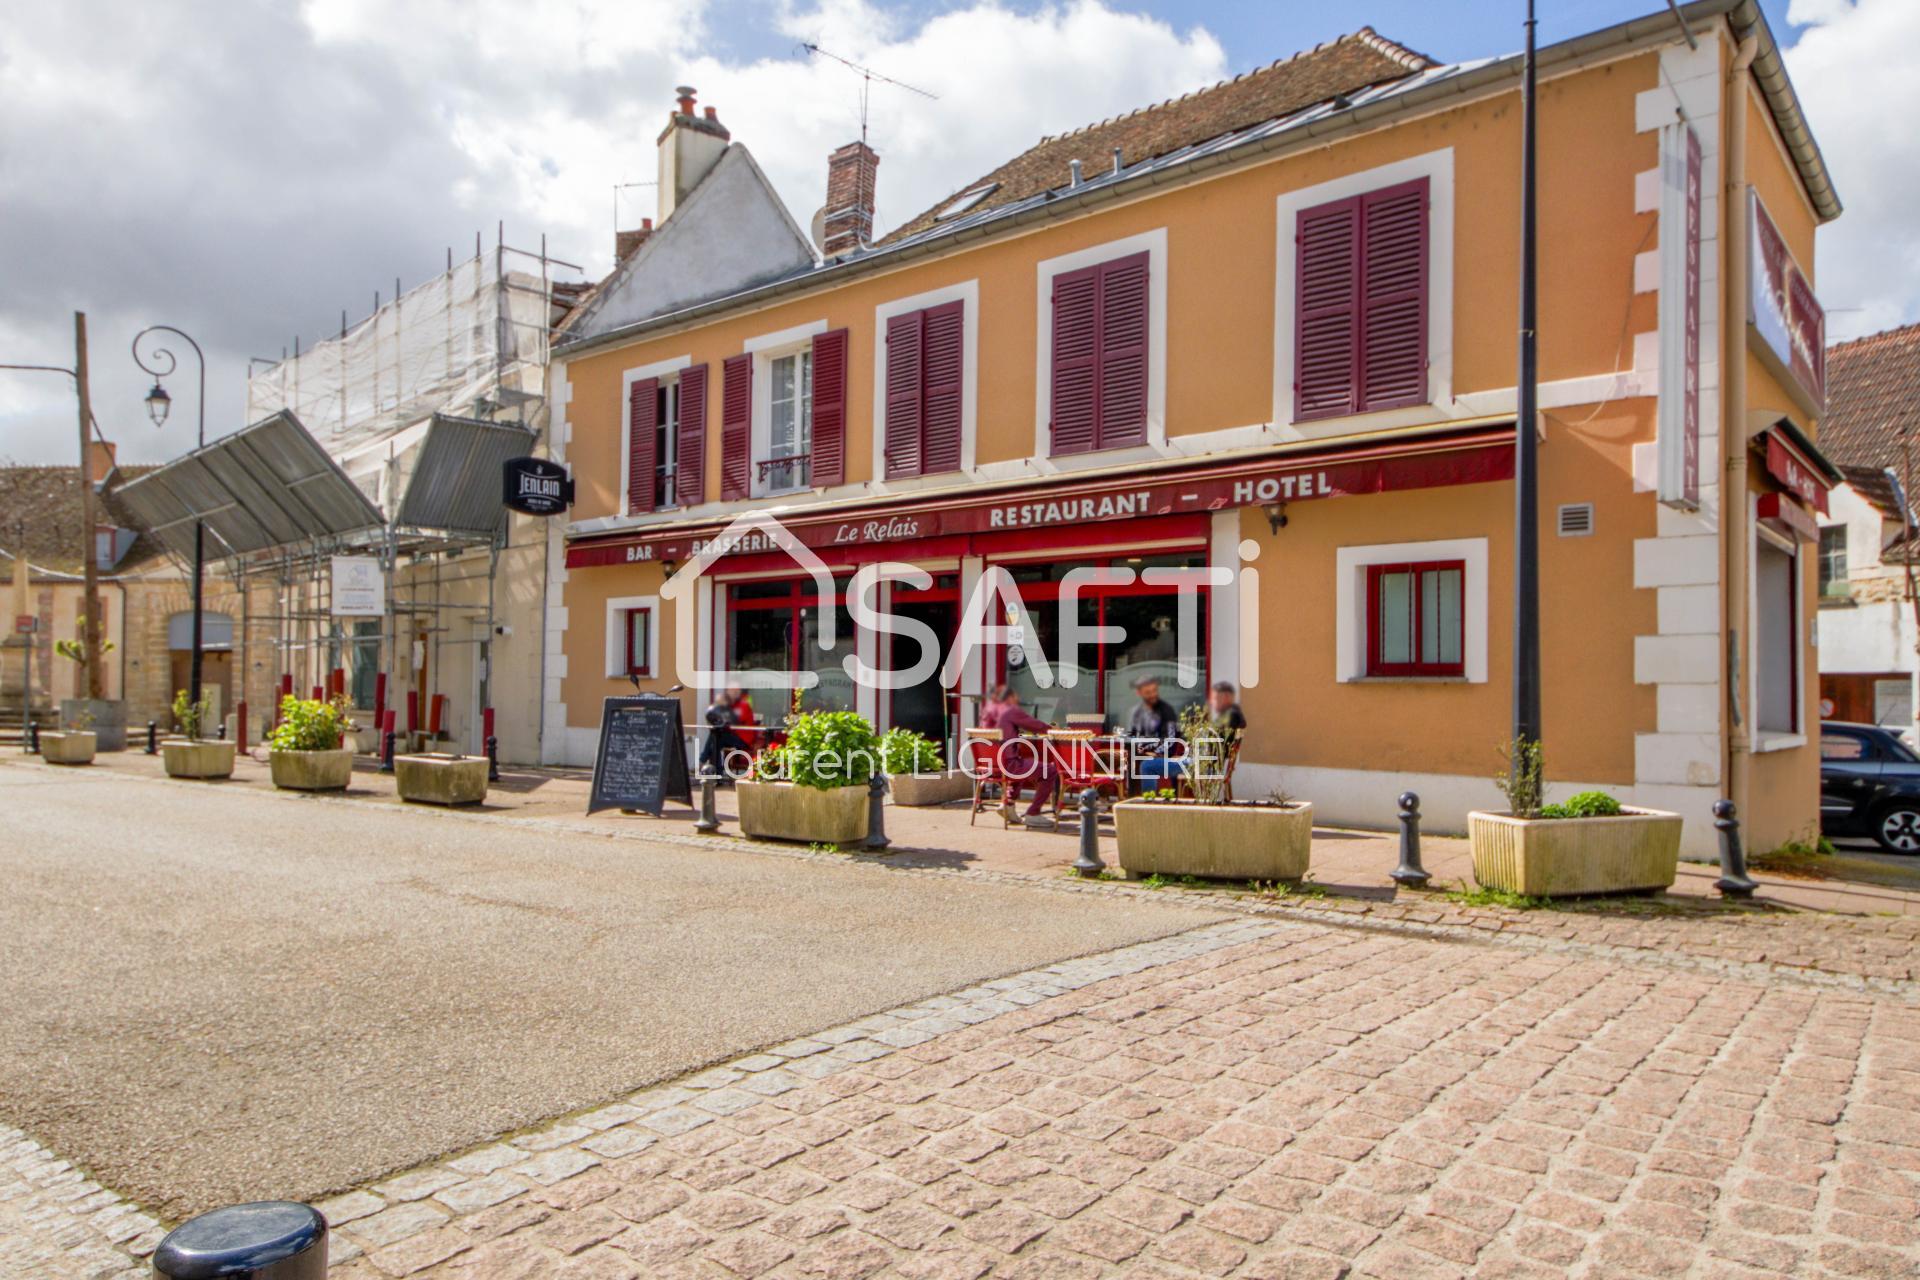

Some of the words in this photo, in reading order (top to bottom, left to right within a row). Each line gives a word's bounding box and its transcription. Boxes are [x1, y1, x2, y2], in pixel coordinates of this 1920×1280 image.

[519, 474, 560, 497] JENLAIN
[990, 492, 1151, 528] RESTAURANT
[1233, 472, 1333, 503] HOTEL
[834, 524, 859, 543] Le
[863, 516, 919, 542] Relais
[626, 545, 653, 562] BAR
[691, 533, 778, 555] BRASSERIE
